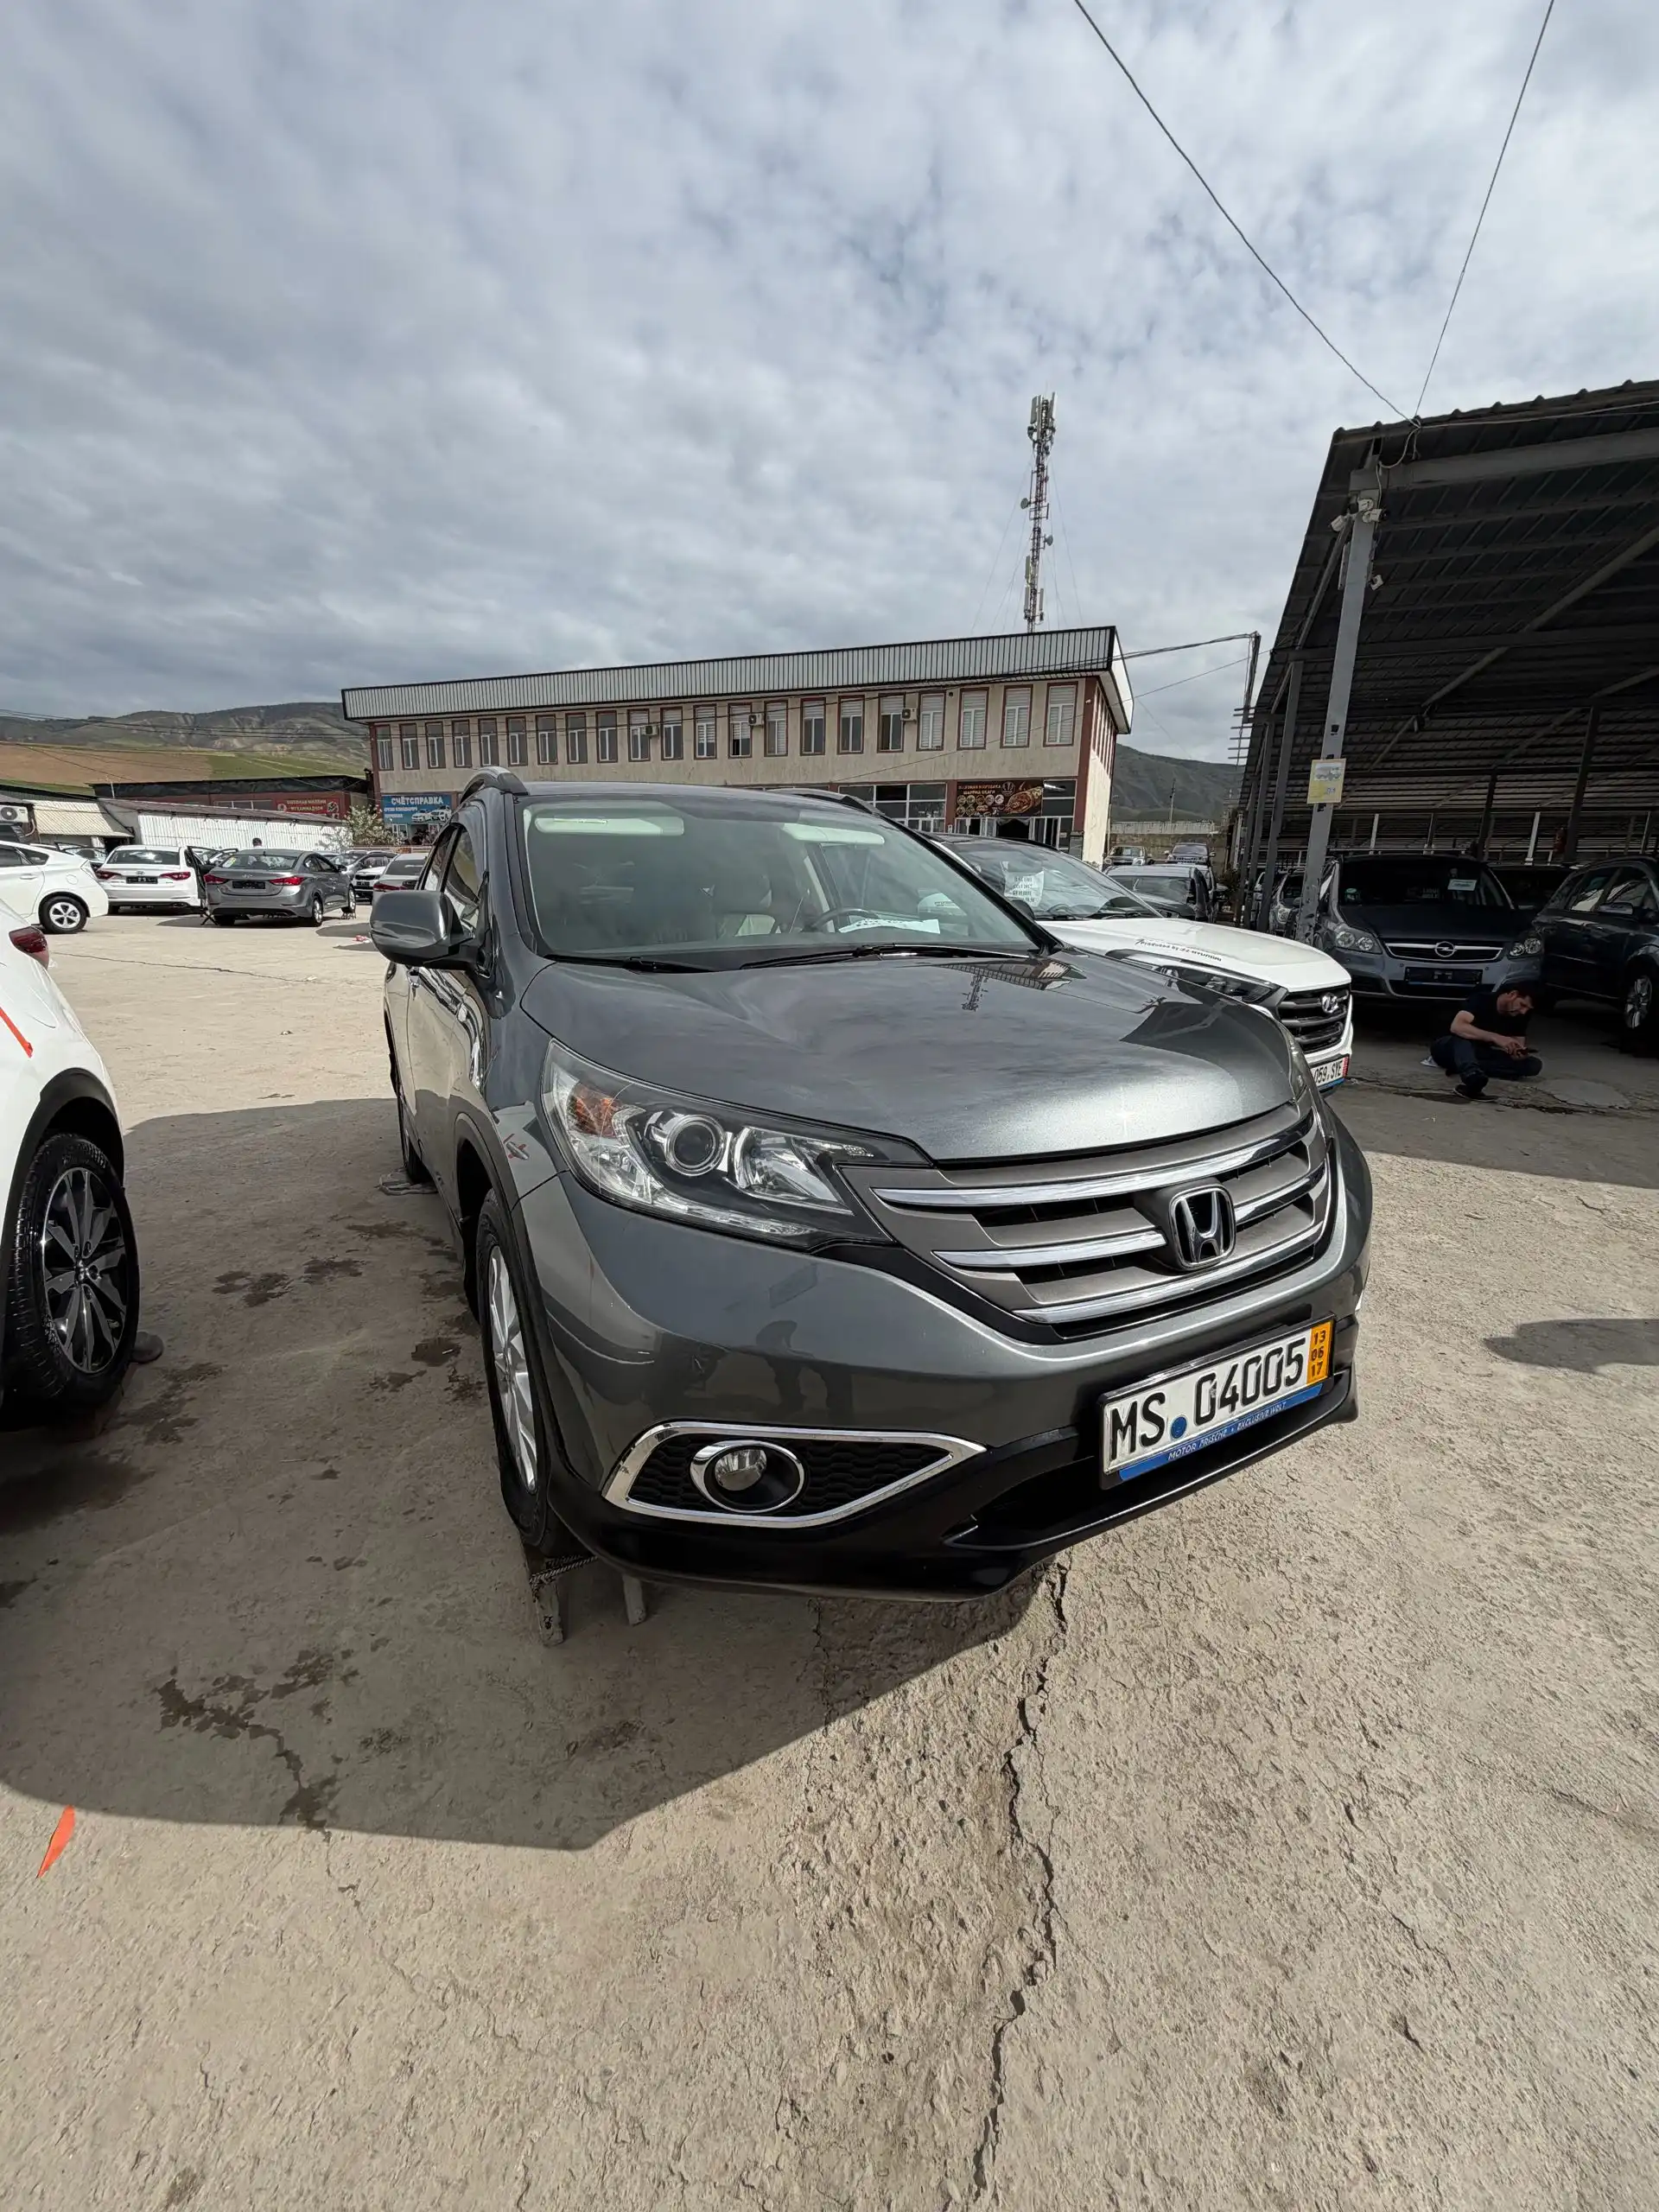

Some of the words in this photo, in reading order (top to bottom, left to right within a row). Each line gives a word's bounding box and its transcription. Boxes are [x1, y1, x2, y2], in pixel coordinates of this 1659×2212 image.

[391, 795, 443, 805] СЧЁТСПРАВКА
[1313, 1330, 1326, 1344] 13
[1311, 1345, 1325, 1362] 06
[1311, 1361, 1324, 1377] 17
[1111, 1391, 1166, 1460] MS
[1194, 1337, 1306, 1427] 04005
[1168, 1443, 1197, 1460] MOTOR
